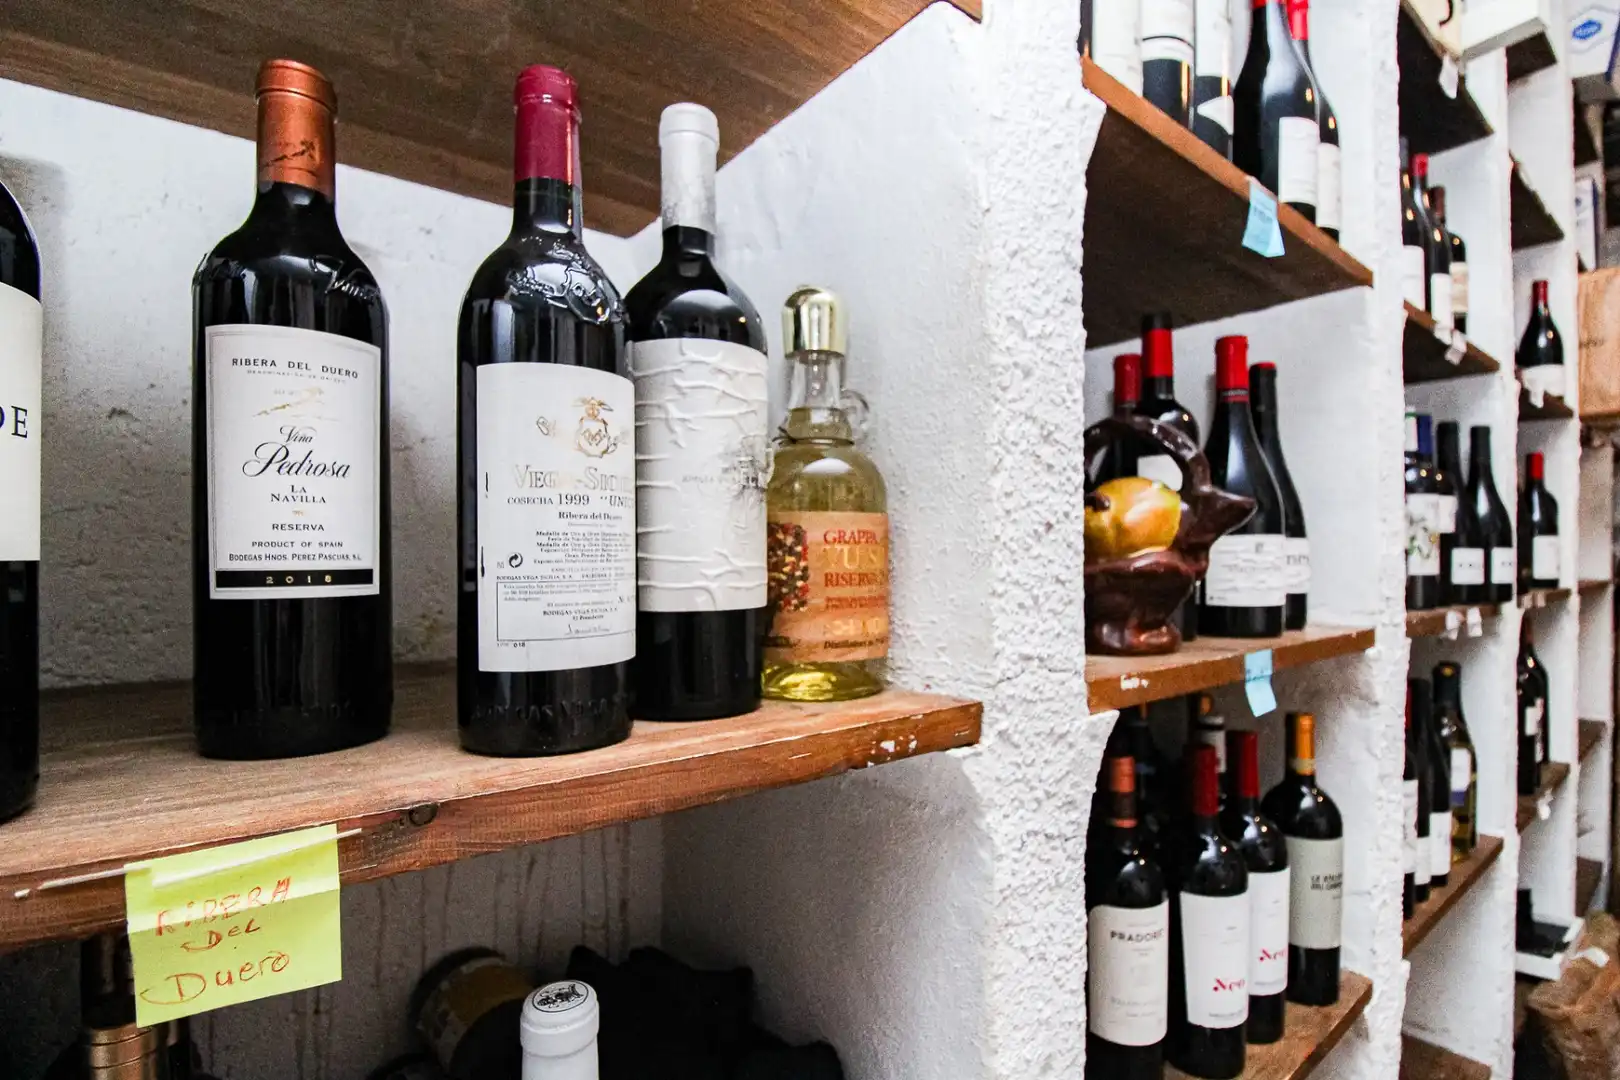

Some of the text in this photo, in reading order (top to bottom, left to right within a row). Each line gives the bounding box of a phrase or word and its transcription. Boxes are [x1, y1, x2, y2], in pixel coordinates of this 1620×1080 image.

[232, 358, 358, 379] RIBERA DEL DUERO
[280, 425, 317, 443] Viña
[242, 441, 351, 479] Pedrosa
[290, 484, 307, 493] LA
[271, 493, 327, 504] NAVILLA
[507, 497, 553, 505] COSECHA
[557, 494, 590, 506] 1999
[558, 511, 588, 519] Ribera
[272, 523, 325, 531] RESERVA
[823, 529, 878, 544] GRAPPA
[229, 553, 262, 561] BODEGAS
[266, 575, 332, 584] 2018
[139, 951, 290, 1005] Duero
